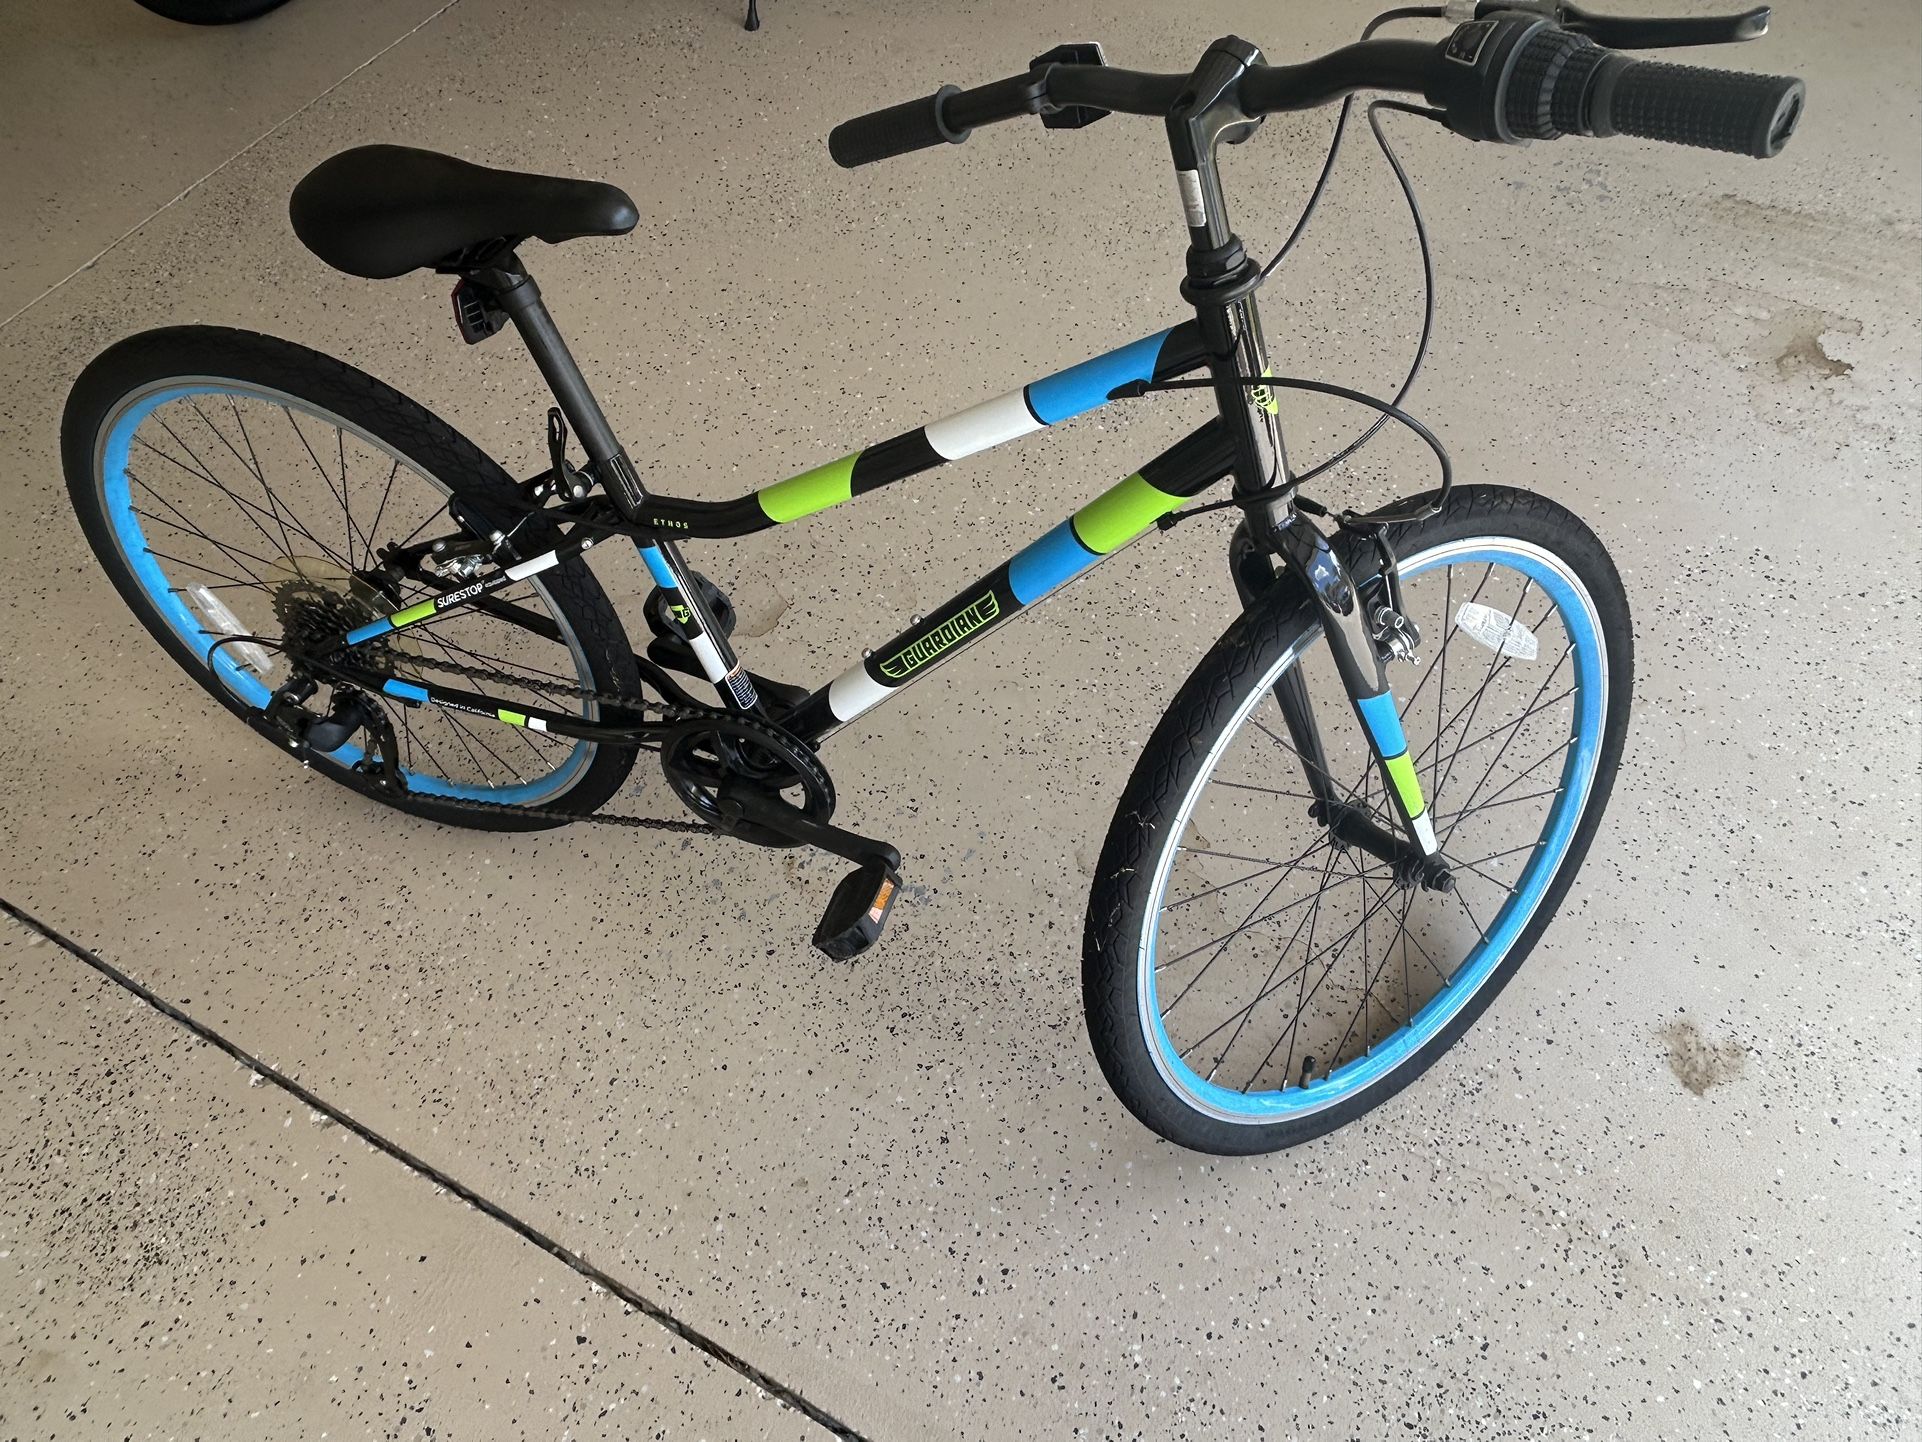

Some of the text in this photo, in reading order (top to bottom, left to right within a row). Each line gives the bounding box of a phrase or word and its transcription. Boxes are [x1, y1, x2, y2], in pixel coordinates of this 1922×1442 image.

[653, 518, 689, 529] ETHOS
[437, 583, 483, 608] SURESTOP
[903, 605, 983, 669] GUARDIAN
[430, 697, 458, 708] Designed
